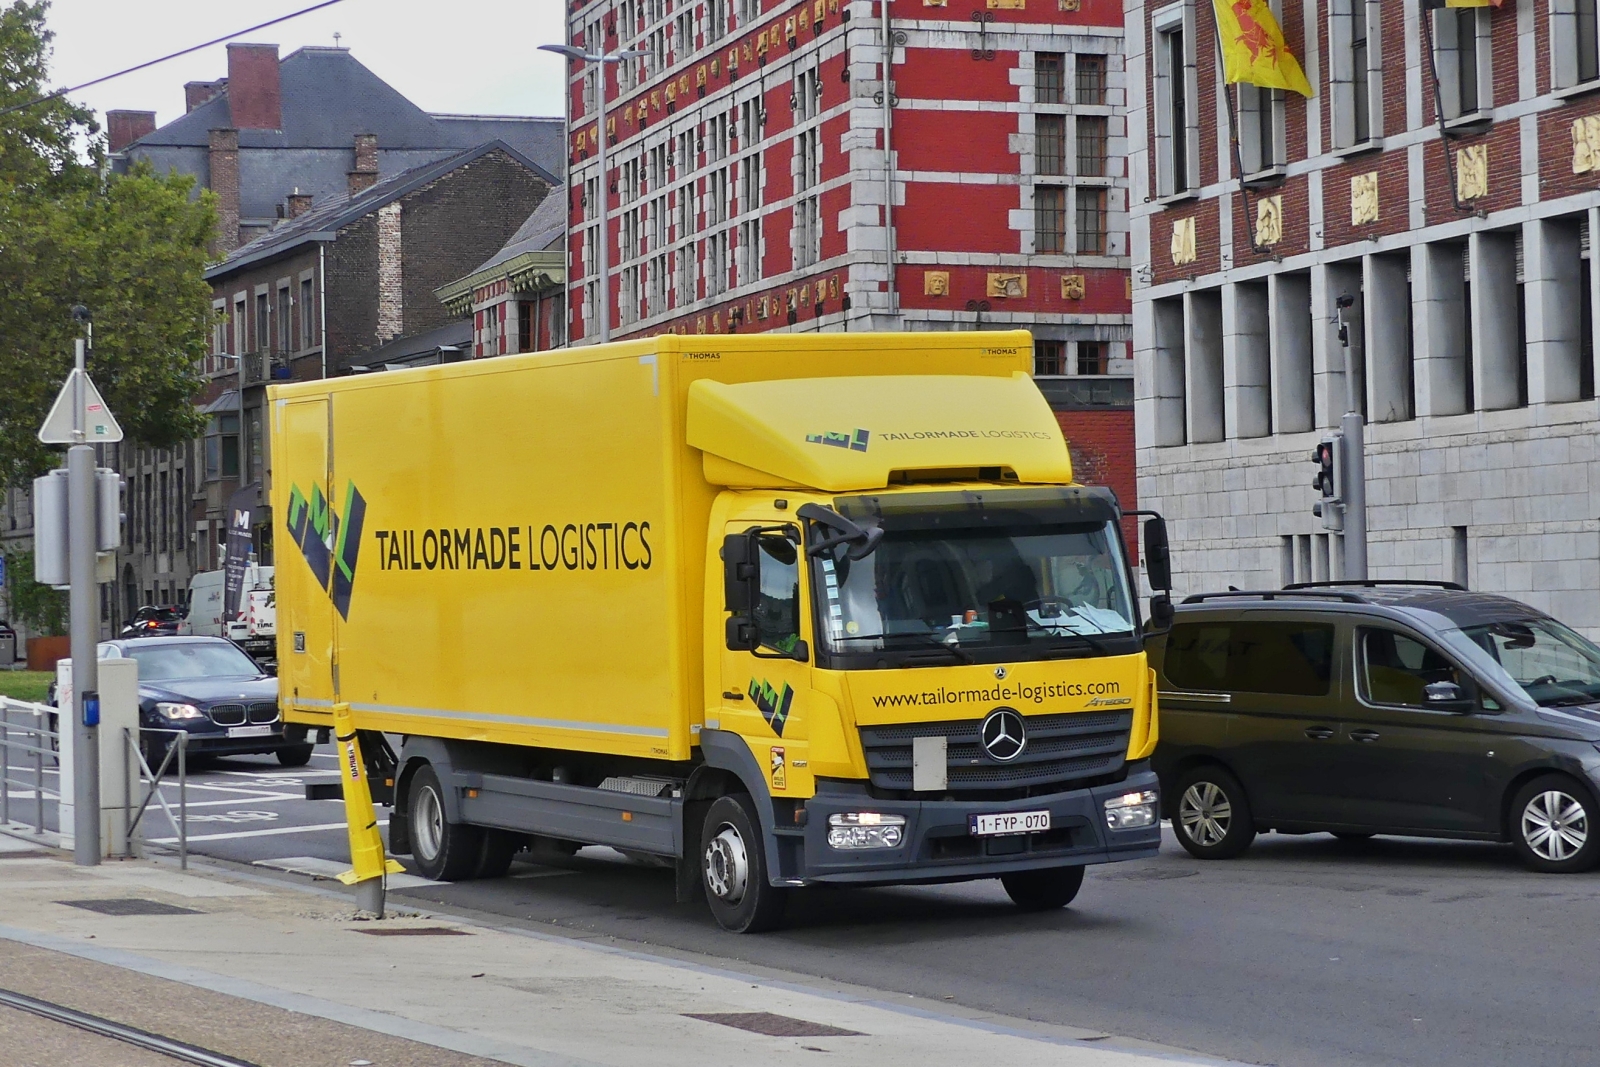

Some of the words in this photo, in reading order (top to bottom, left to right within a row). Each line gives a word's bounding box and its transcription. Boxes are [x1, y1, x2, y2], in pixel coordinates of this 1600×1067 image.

[806, 428, 868, 450] TML
[879, 429, 980, 441] TAILORMADE
[980, 429, 1051, 441] LOGISTICS
[375, 526, 521, 570] TAILORMADE
[528, 521, 652, 570] LOGISTICS
[872, 681, 1120, 708] www.tailormade-logistics.com
[980, 814, 1048, 832] 1-FYP-070
